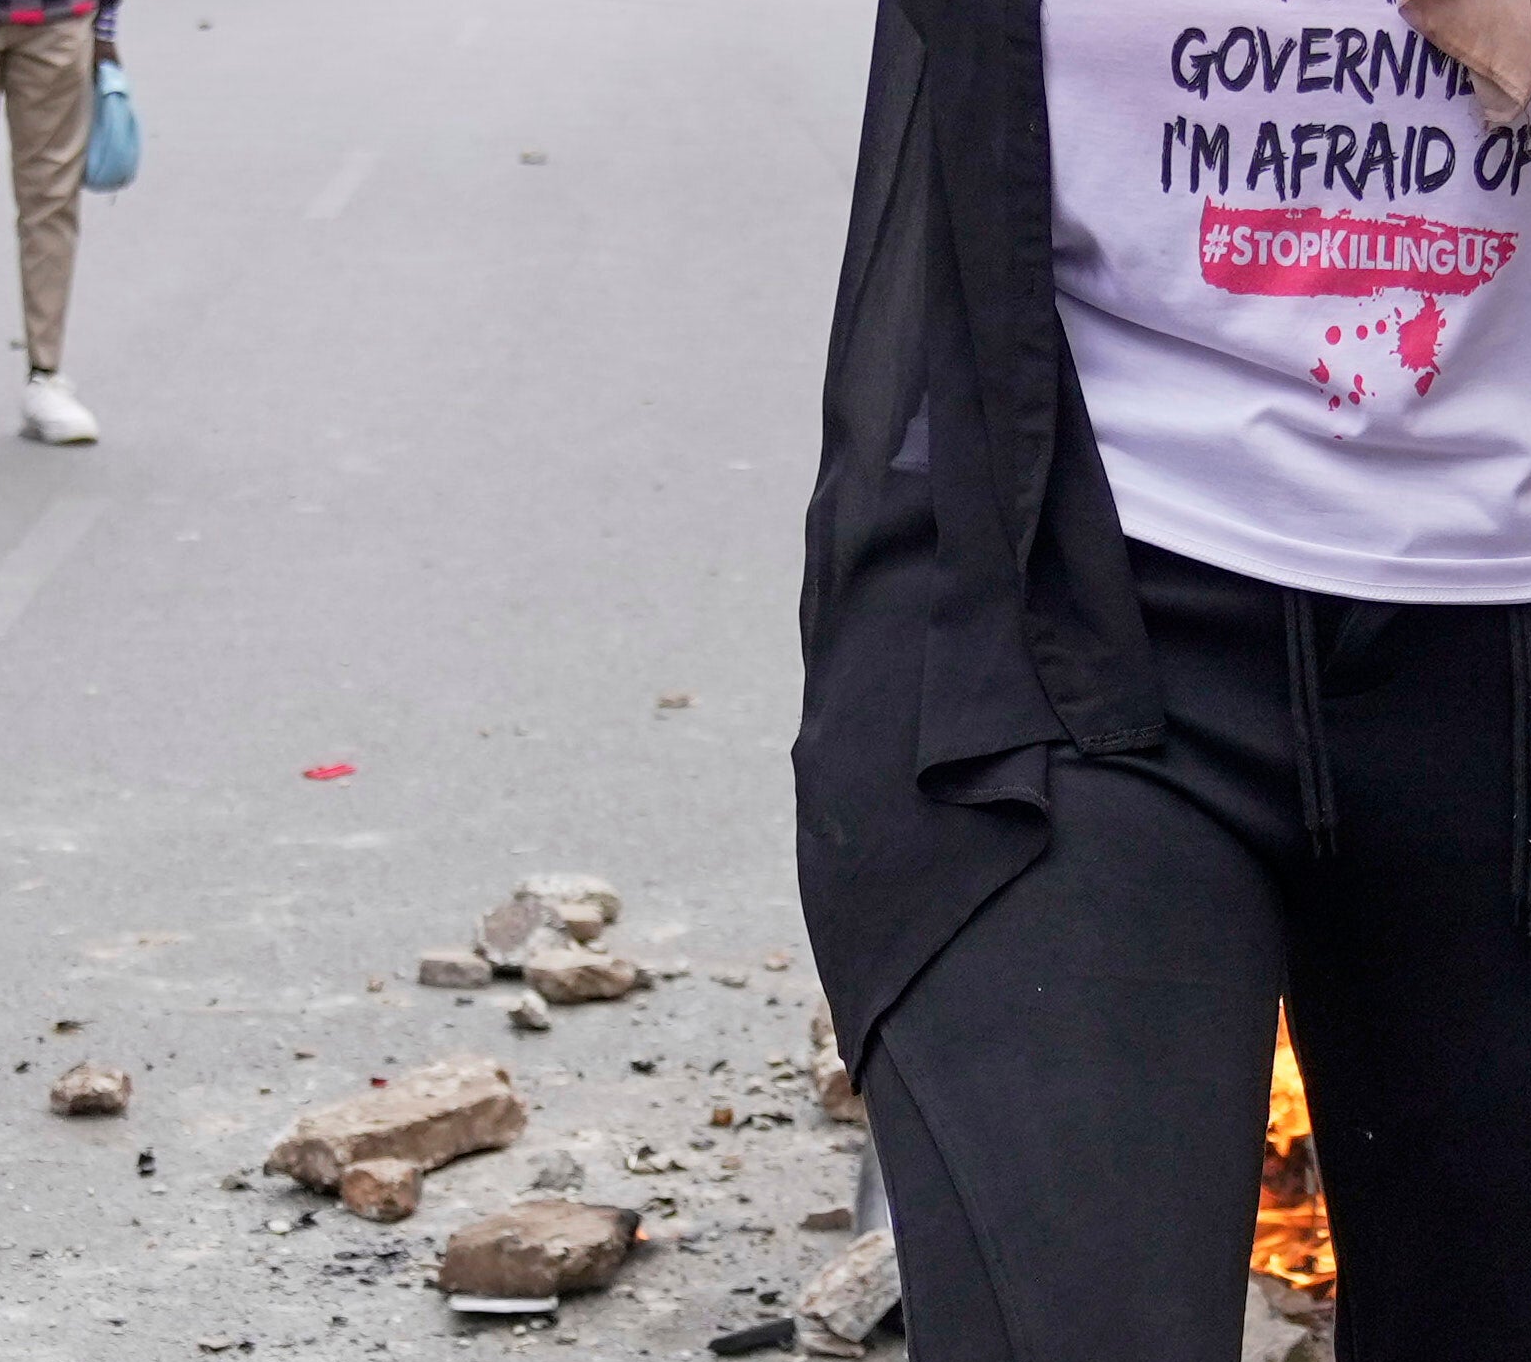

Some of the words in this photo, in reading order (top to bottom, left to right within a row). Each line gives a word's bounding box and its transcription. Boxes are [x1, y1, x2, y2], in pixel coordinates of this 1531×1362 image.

[1161, 116, 1229, 195] I'M
[1246, 120, 1457, 201] AFRAID
[1202, 223, 1501, 276] #STOPKILLINGUS
